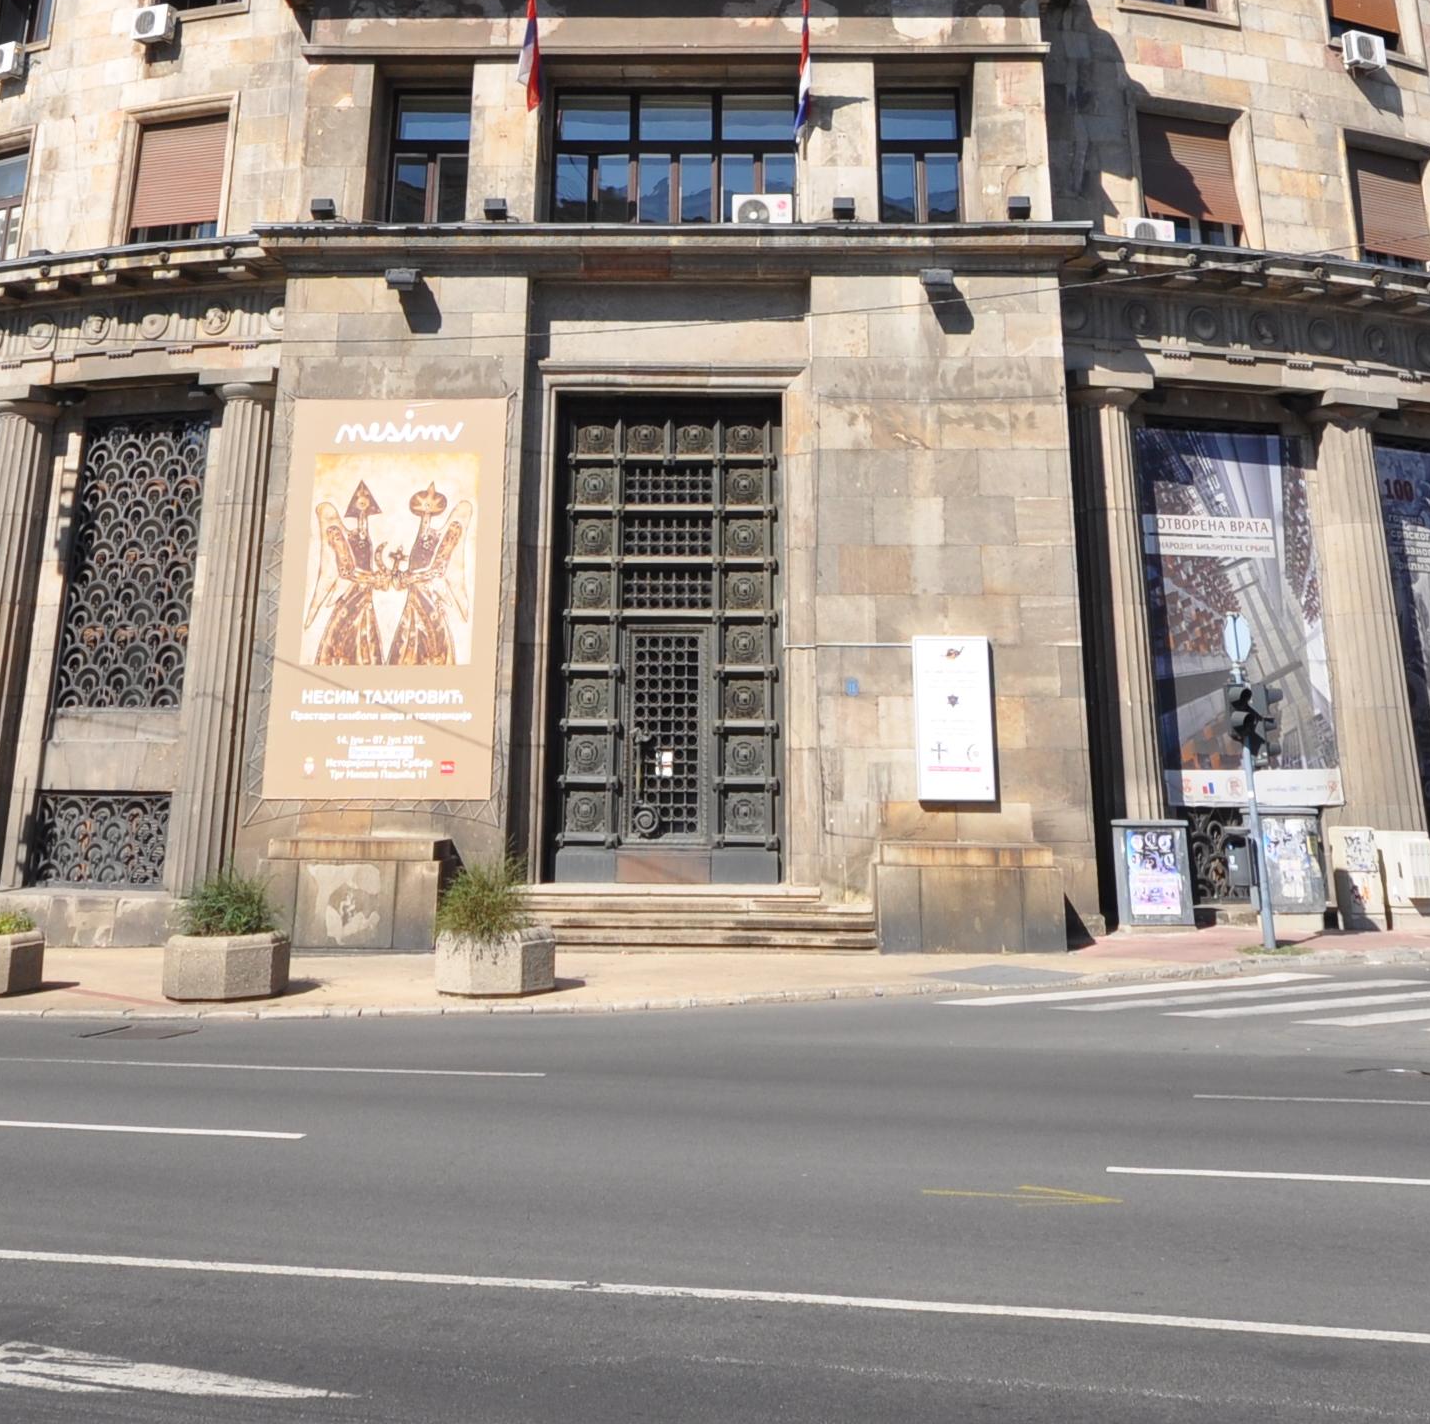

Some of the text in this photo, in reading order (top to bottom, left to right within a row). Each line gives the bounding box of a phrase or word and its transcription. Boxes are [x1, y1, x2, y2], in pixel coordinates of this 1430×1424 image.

[1384, 478, 1414, 502] 100
[1157, 517, 1269, 533] ОТВОРЕНА ВРАТА
[1391, 529, 1430, 541] српског
[1196, 543, 1243, 552] БИБЛИОТЕКЕ
[302, 690, 463, 704] НЕСИМ ТАХИРОВИЋ
[291, 710, 335, 722] Прастари
[337, 711, 379, 721] симболи
[380, 712, 404, 722] мира
[415, 711, 472, 723] толеранције
[336, 735, 349, 744] 14.
[350, 735, 364, 746] јун
[372, 735, 385, 744] 07.
[387, 735, 401, 746] јул
[403, 735, 425, 745] 2012.
[326, 758, 375, 769] Историјски
[376, 760, 401, 769] музеј
[402, 758, 433, 769] Србије
[330, 770, 427, 780] Трг Николе Пашића 11
